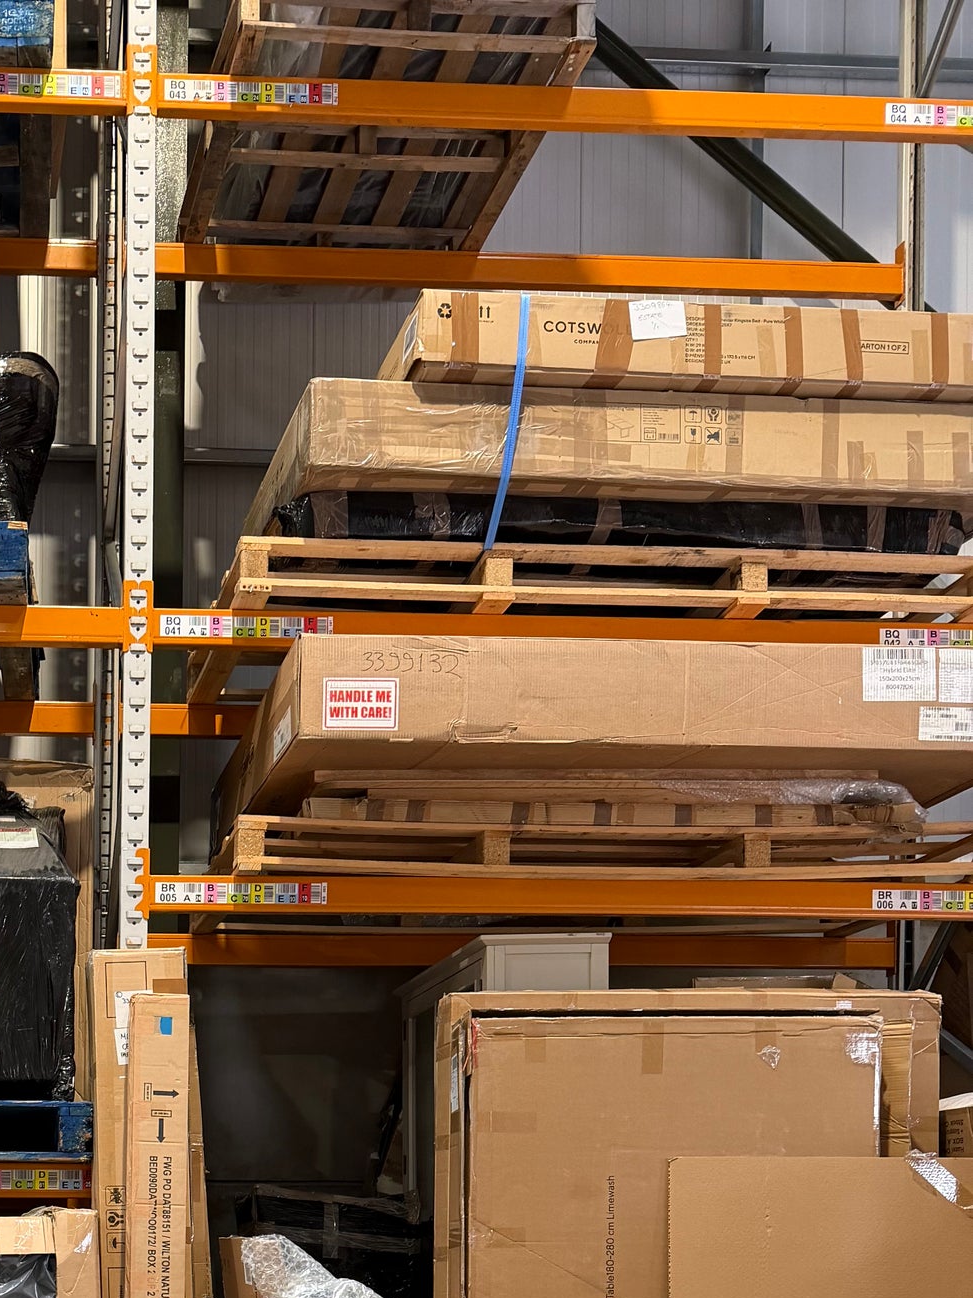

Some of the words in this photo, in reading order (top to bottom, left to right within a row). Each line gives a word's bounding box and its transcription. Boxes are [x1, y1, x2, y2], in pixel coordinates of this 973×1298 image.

[170, 80, 186, 90] BQ
[169, 90, 187, 100] 043
[891, 104, 907, 114] BQ
[891, 114, 907, 123] 044
[902, 344, 907, 352] 2
[166, 616, 181, 626] BQ
[165, 626, 181, 636] 041
[885, 630, 900, 639] BQ
[361, 652, 462, 679] 3399132
[329, 690, 373, 703] HANDLE
[375, 690, 392, 703] ME
[329, 706, 358, 718] WITH
[361, 706, 392, 718] CARE!
[161, 884, 176, 892] BR
[207, 884, 215, 892] B
[159, 892, 177, 902] 005
[183, 894, 191, 902] A
[878, 890, 893, 900] BR
[876, 900, 894, 909] 006
[163, 1156, 172, 1176] FWG
[163, 1178, 171, 1190] PO
[606, 1175, 615, 1220] Limewash
[161, 1193, 171, 1234] DAT88151
[608, 1222, 615, 1236] cm
[147, 1249, 157, 1268] BOX
[161, 1240, 171, 1274] WILTON
[605, 1237, 615, 1298] Table180-280
